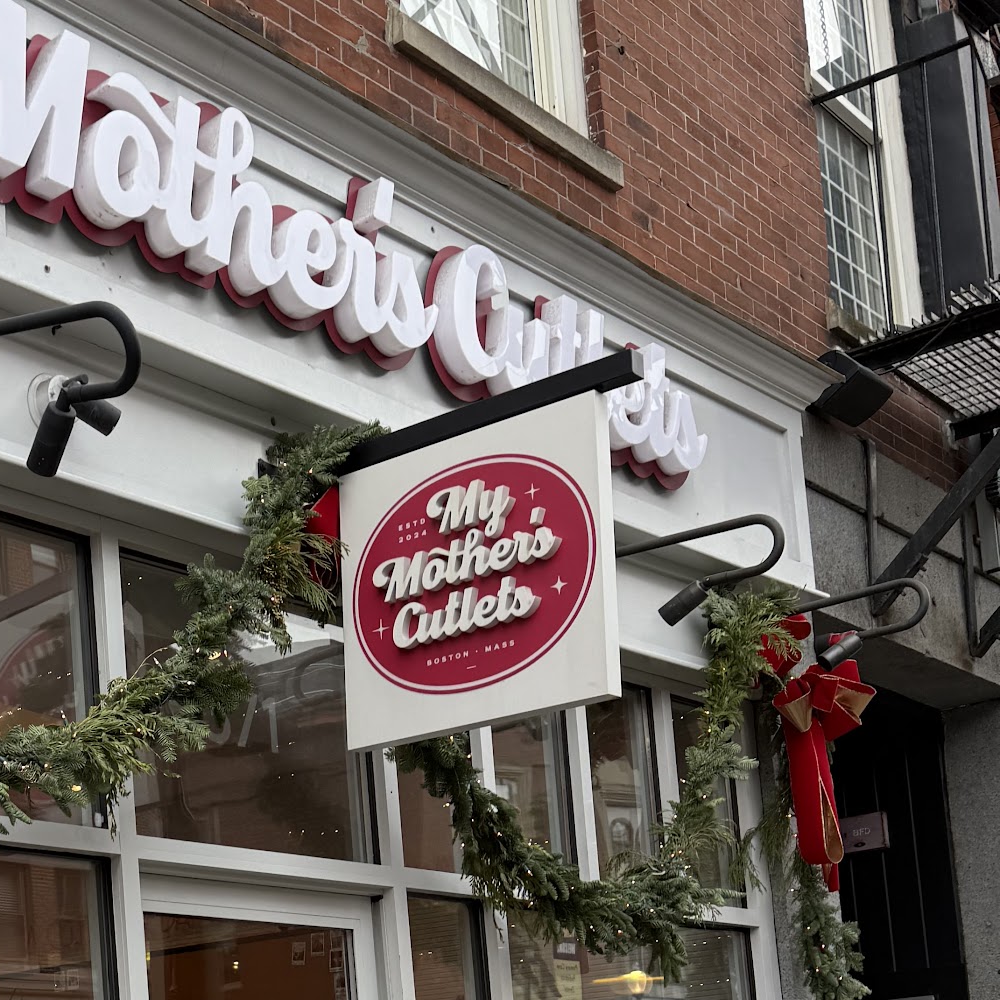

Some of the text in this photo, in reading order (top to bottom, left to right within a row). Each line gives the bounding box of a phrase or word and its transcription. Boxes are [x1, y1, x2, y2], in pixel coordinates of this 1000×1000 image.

[398, 518, 426, 532] ESTD
[426, 479, 516, 538] My
[373, 507, 562, 603] Mother's
[398, 530, 428, 543] 2024
[393, 576, 542, 650] Cutlets
[426, 639, 516, 667] BOSTON MASS
